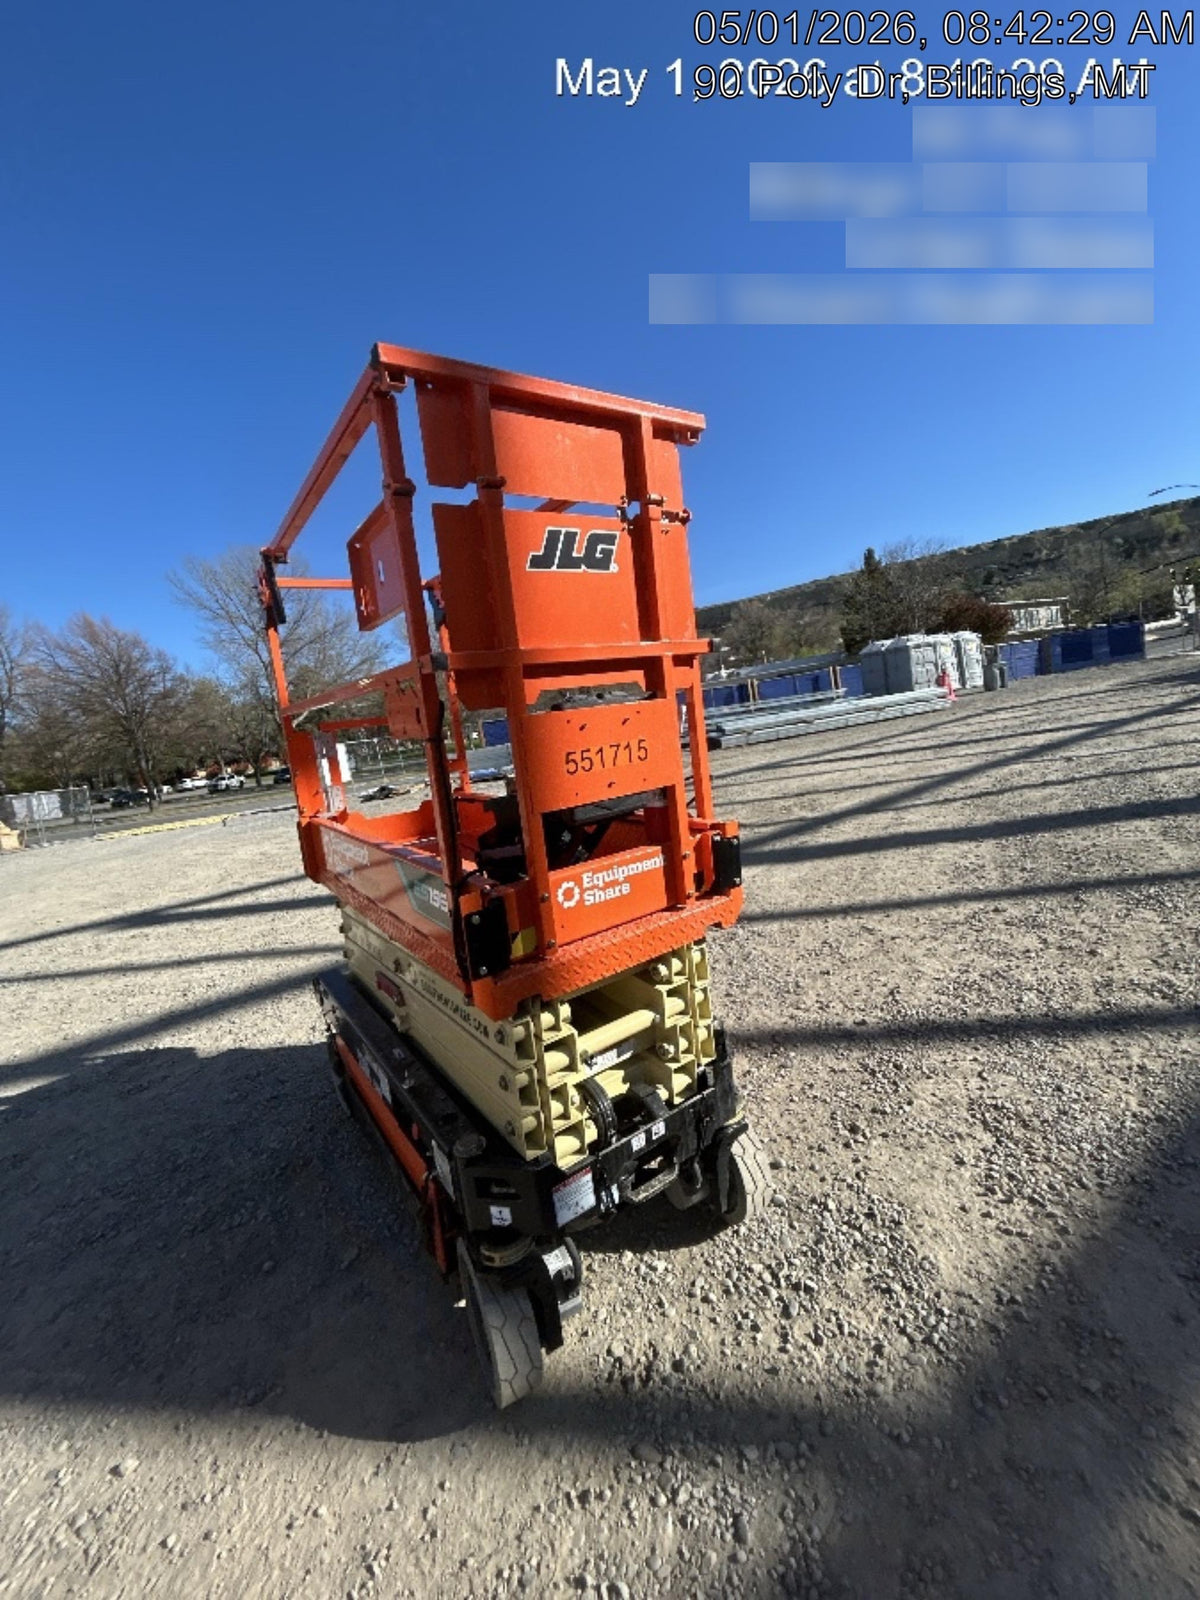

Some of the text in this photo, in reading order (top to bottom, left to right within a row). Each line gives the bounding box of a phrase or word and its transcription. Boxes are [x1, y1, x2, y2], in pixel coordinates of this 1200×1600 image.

[526, 526, 619, 573] JLG
[564, 738, 648, 776] 551715
[583, 883, 630, 906] Share
